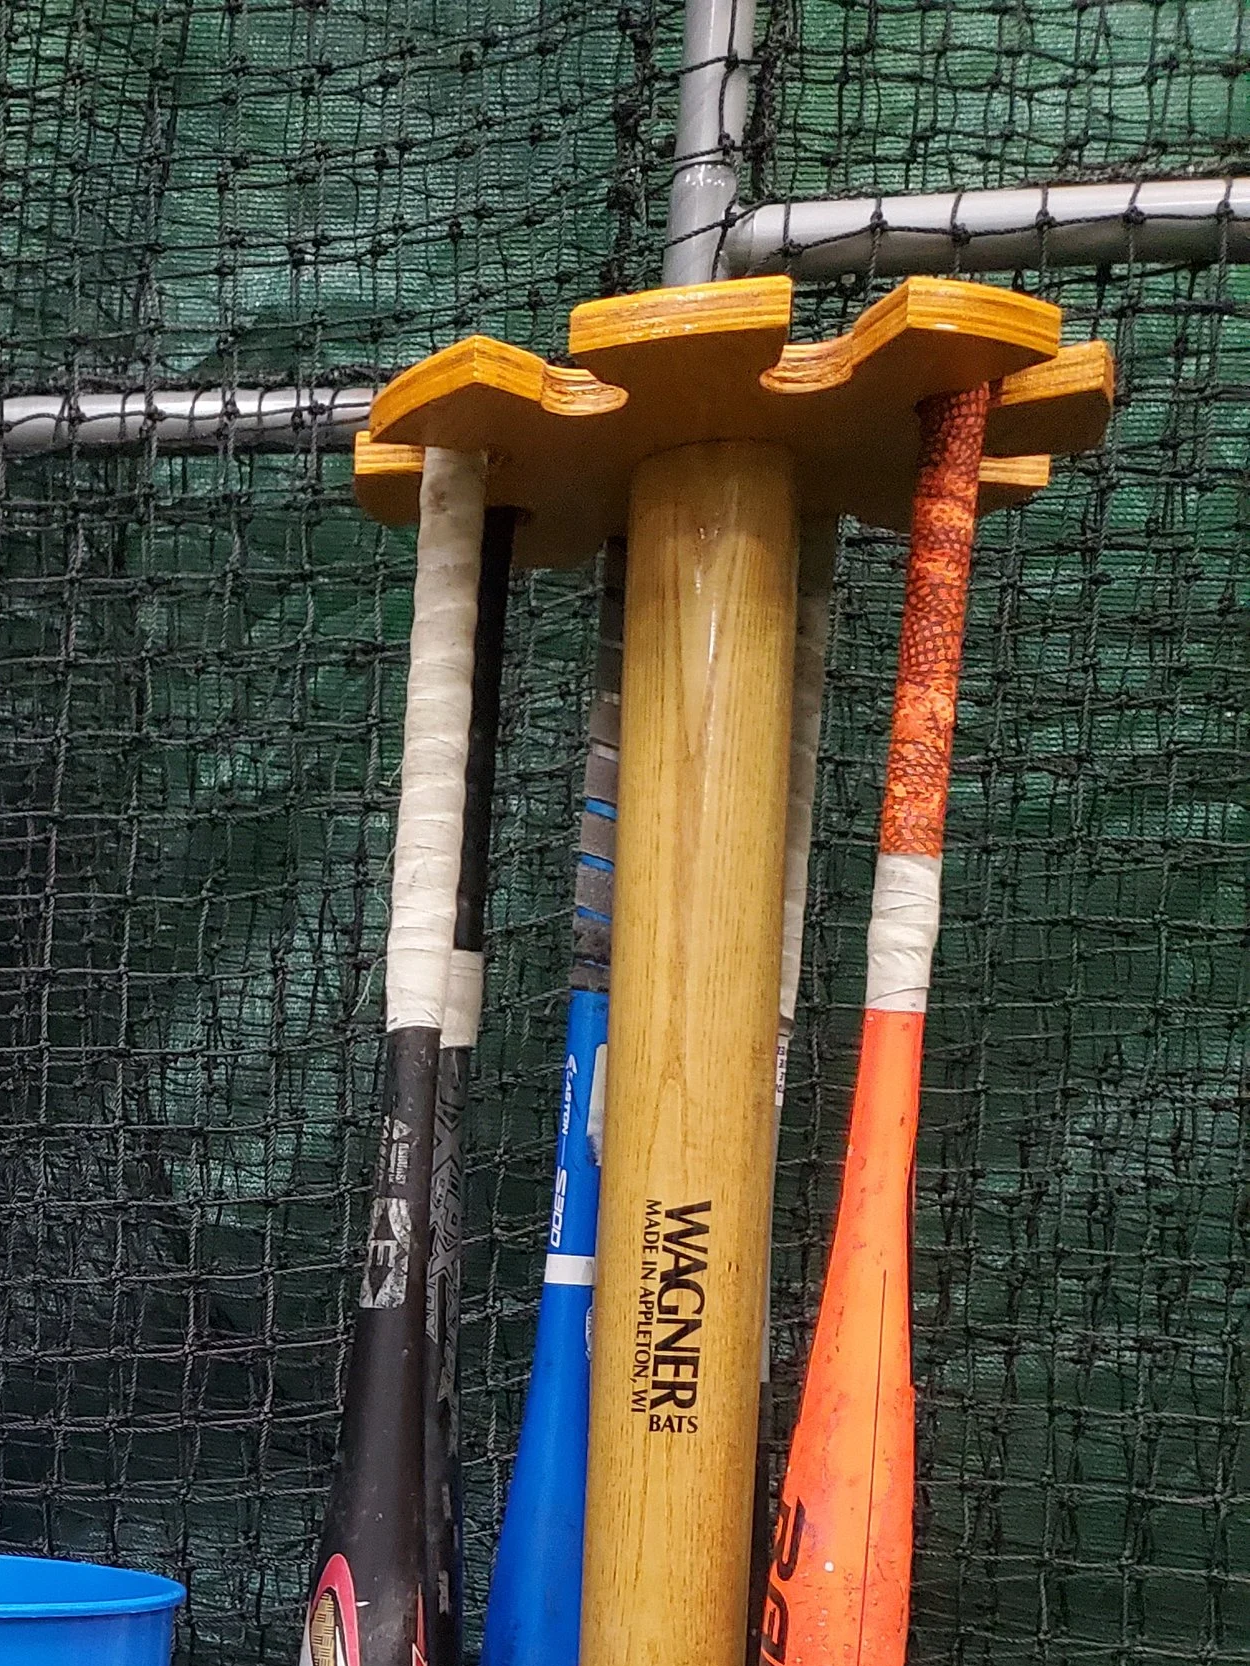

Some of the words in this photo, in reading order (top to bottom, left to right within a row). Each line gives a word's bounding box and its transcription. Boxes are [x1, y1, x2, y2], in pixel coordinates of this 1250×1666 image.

[550, 1166, 568, 1248] S300
[643, 1199, 662, 1254] MADE
[640, 1261, 657, 1280] IN
[650, 1200, 712, 1410] WAGNER
[630, 1286, 655, 1383] APPLETON,
[631, 1389, 648, 1413] WI
[649, 1414, 698, 1433] BATS
